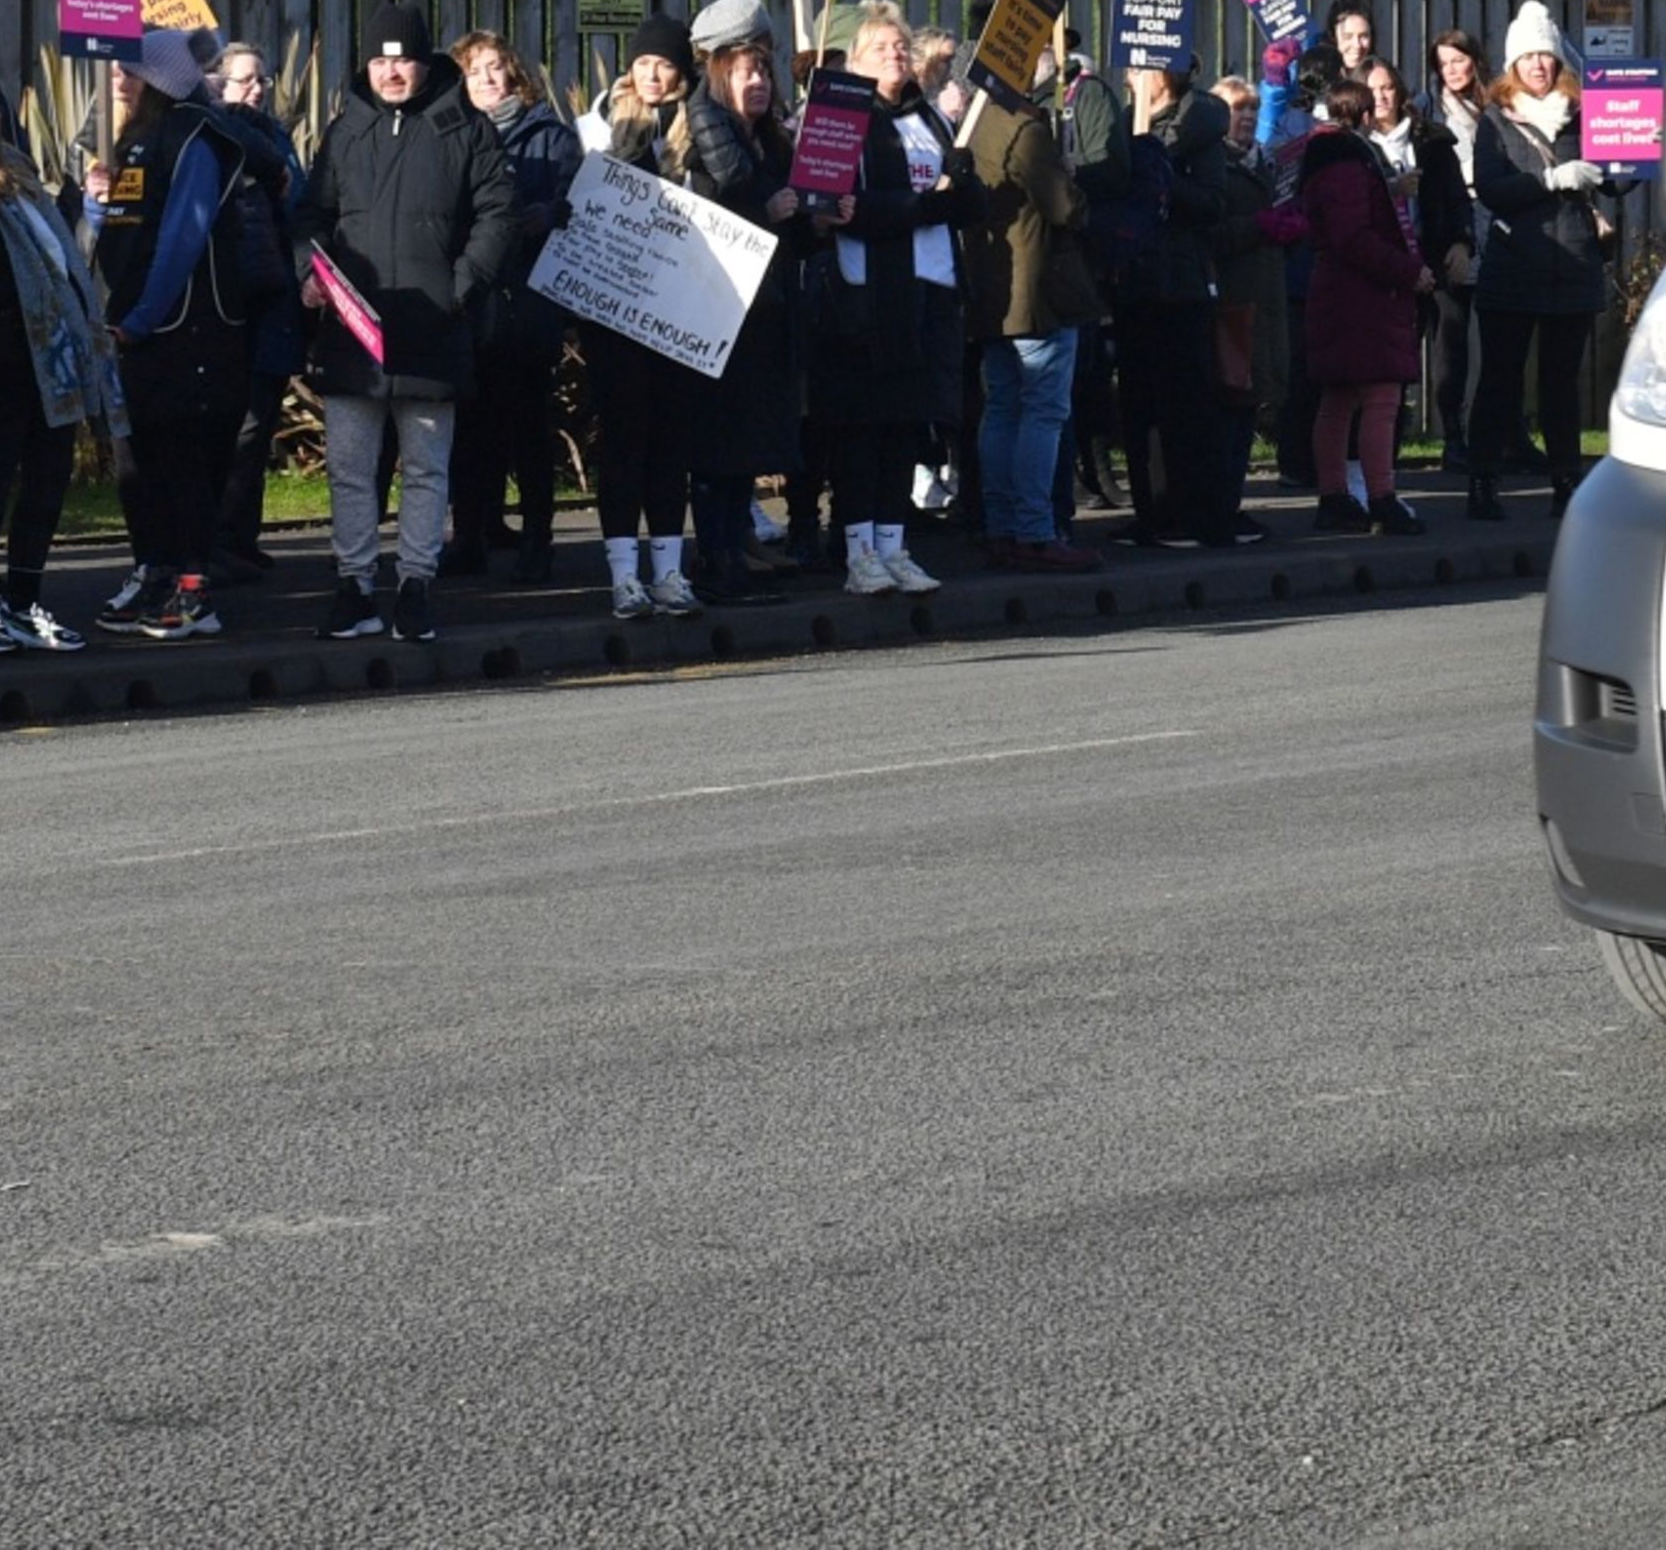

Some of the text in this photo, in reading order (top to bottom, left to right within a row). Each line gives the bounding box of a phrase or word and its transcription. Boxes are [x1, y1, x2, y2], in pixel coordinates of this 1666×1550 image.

[1122, 5, 1183, 20] FAIR PAY
[1138, 19, 1167, 32] FOR
[1120, 31, 1182, 48] NURSING
[1605, 100, 1641, 112] Staff
[1589, 117, 1657, 130] shortages
[1592, 132, 1622, 145] cost
[602, 157, 651, 205] Things
[747, 233, 769, 258] the
[552, 269, 621, 318] ENOUGH
[622, 305, 636, 324] IS
